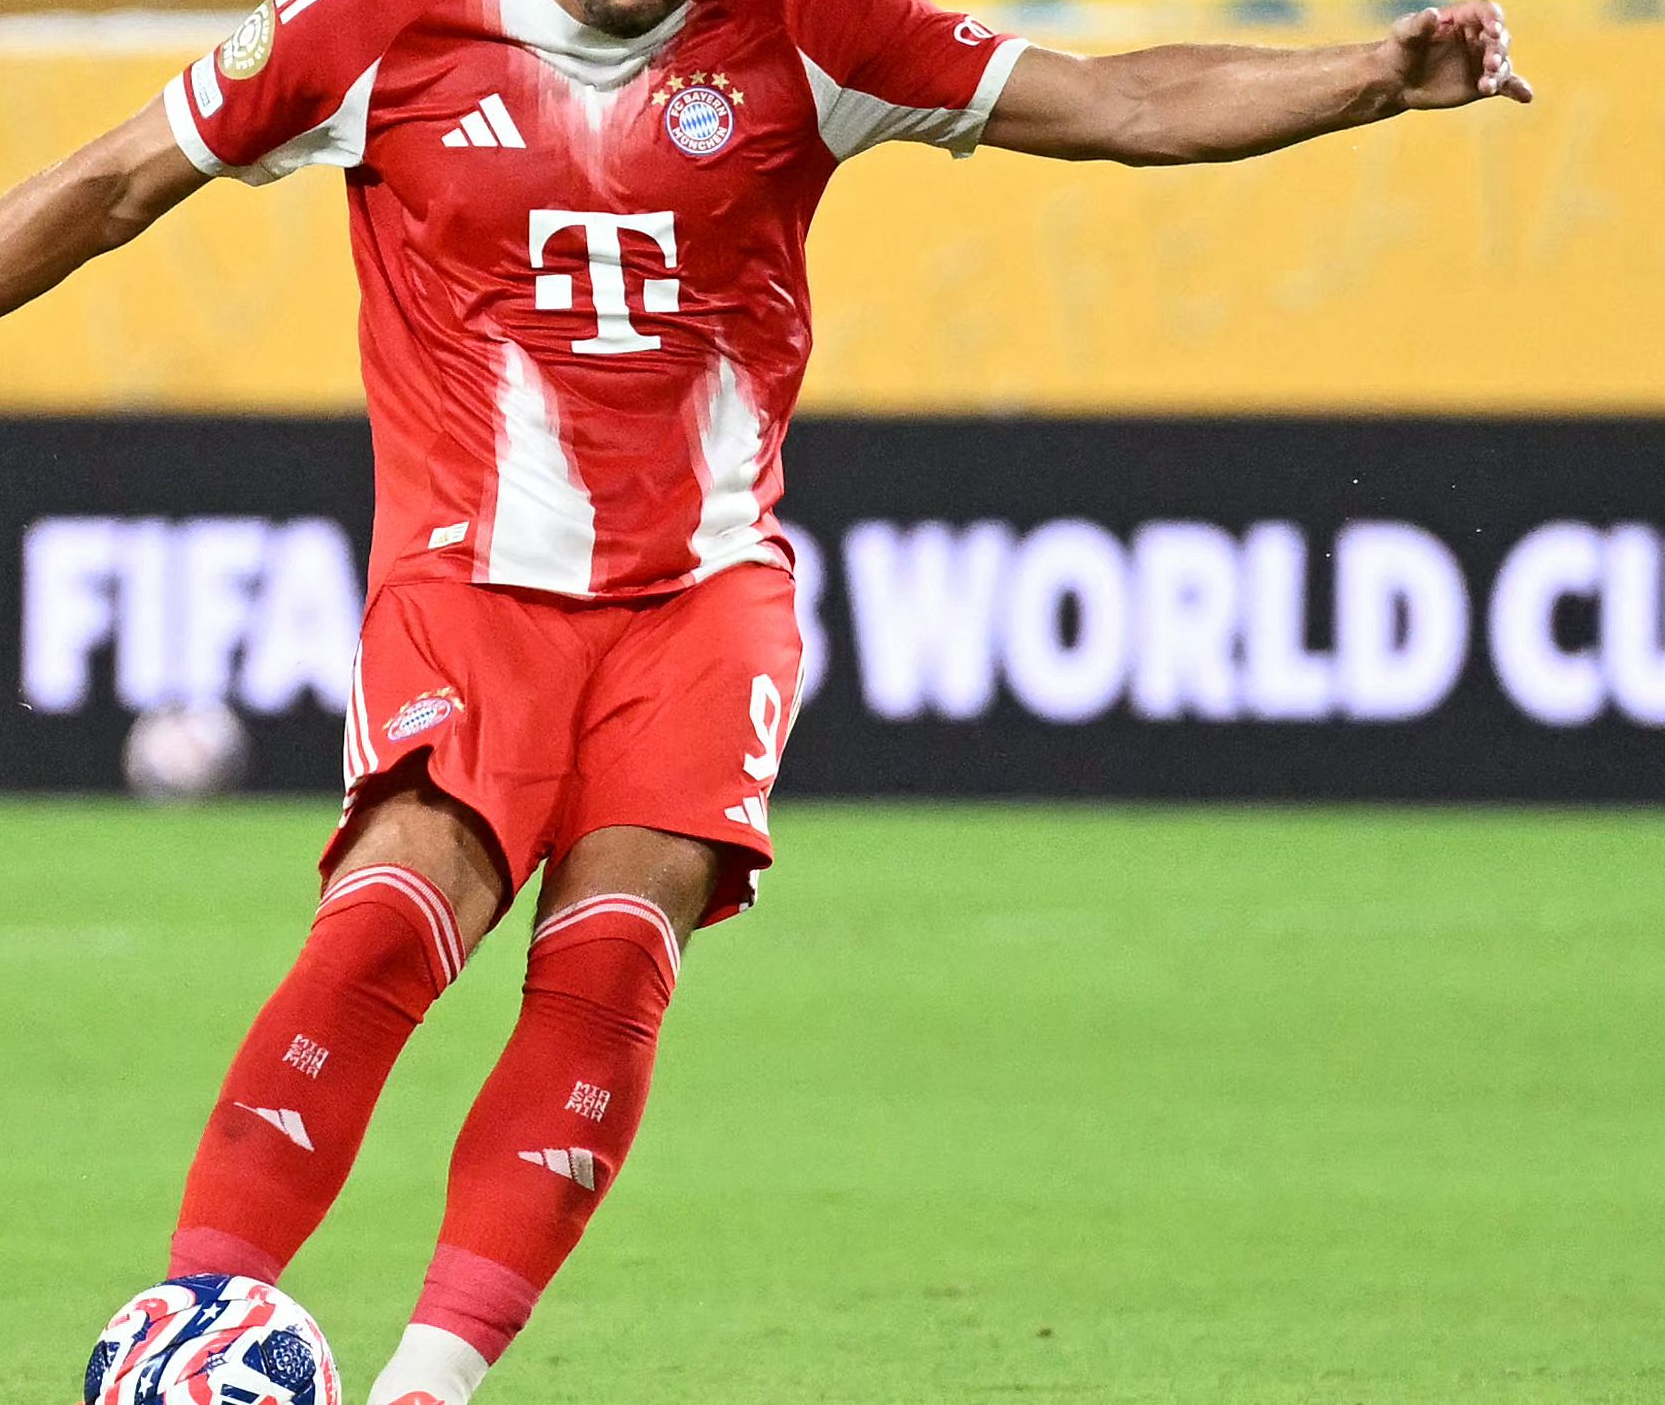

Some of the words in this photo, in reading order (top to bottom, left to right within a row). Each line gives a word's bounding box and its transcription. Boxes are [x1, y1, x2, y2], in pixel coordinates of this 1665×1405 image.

[670, 100, 684, 117] FC
[683, 92, 727, 117] BAYERN
[22, 515, 364, 714] FIFA
[844, 519, 1469, 722] WORLD
[743, 674, 781, 781] 9
[570, 1091, 607, 1113] SAN
[574, 1081, 610, 1102] MIA
[564, 1100, 602, 1122] MIA
